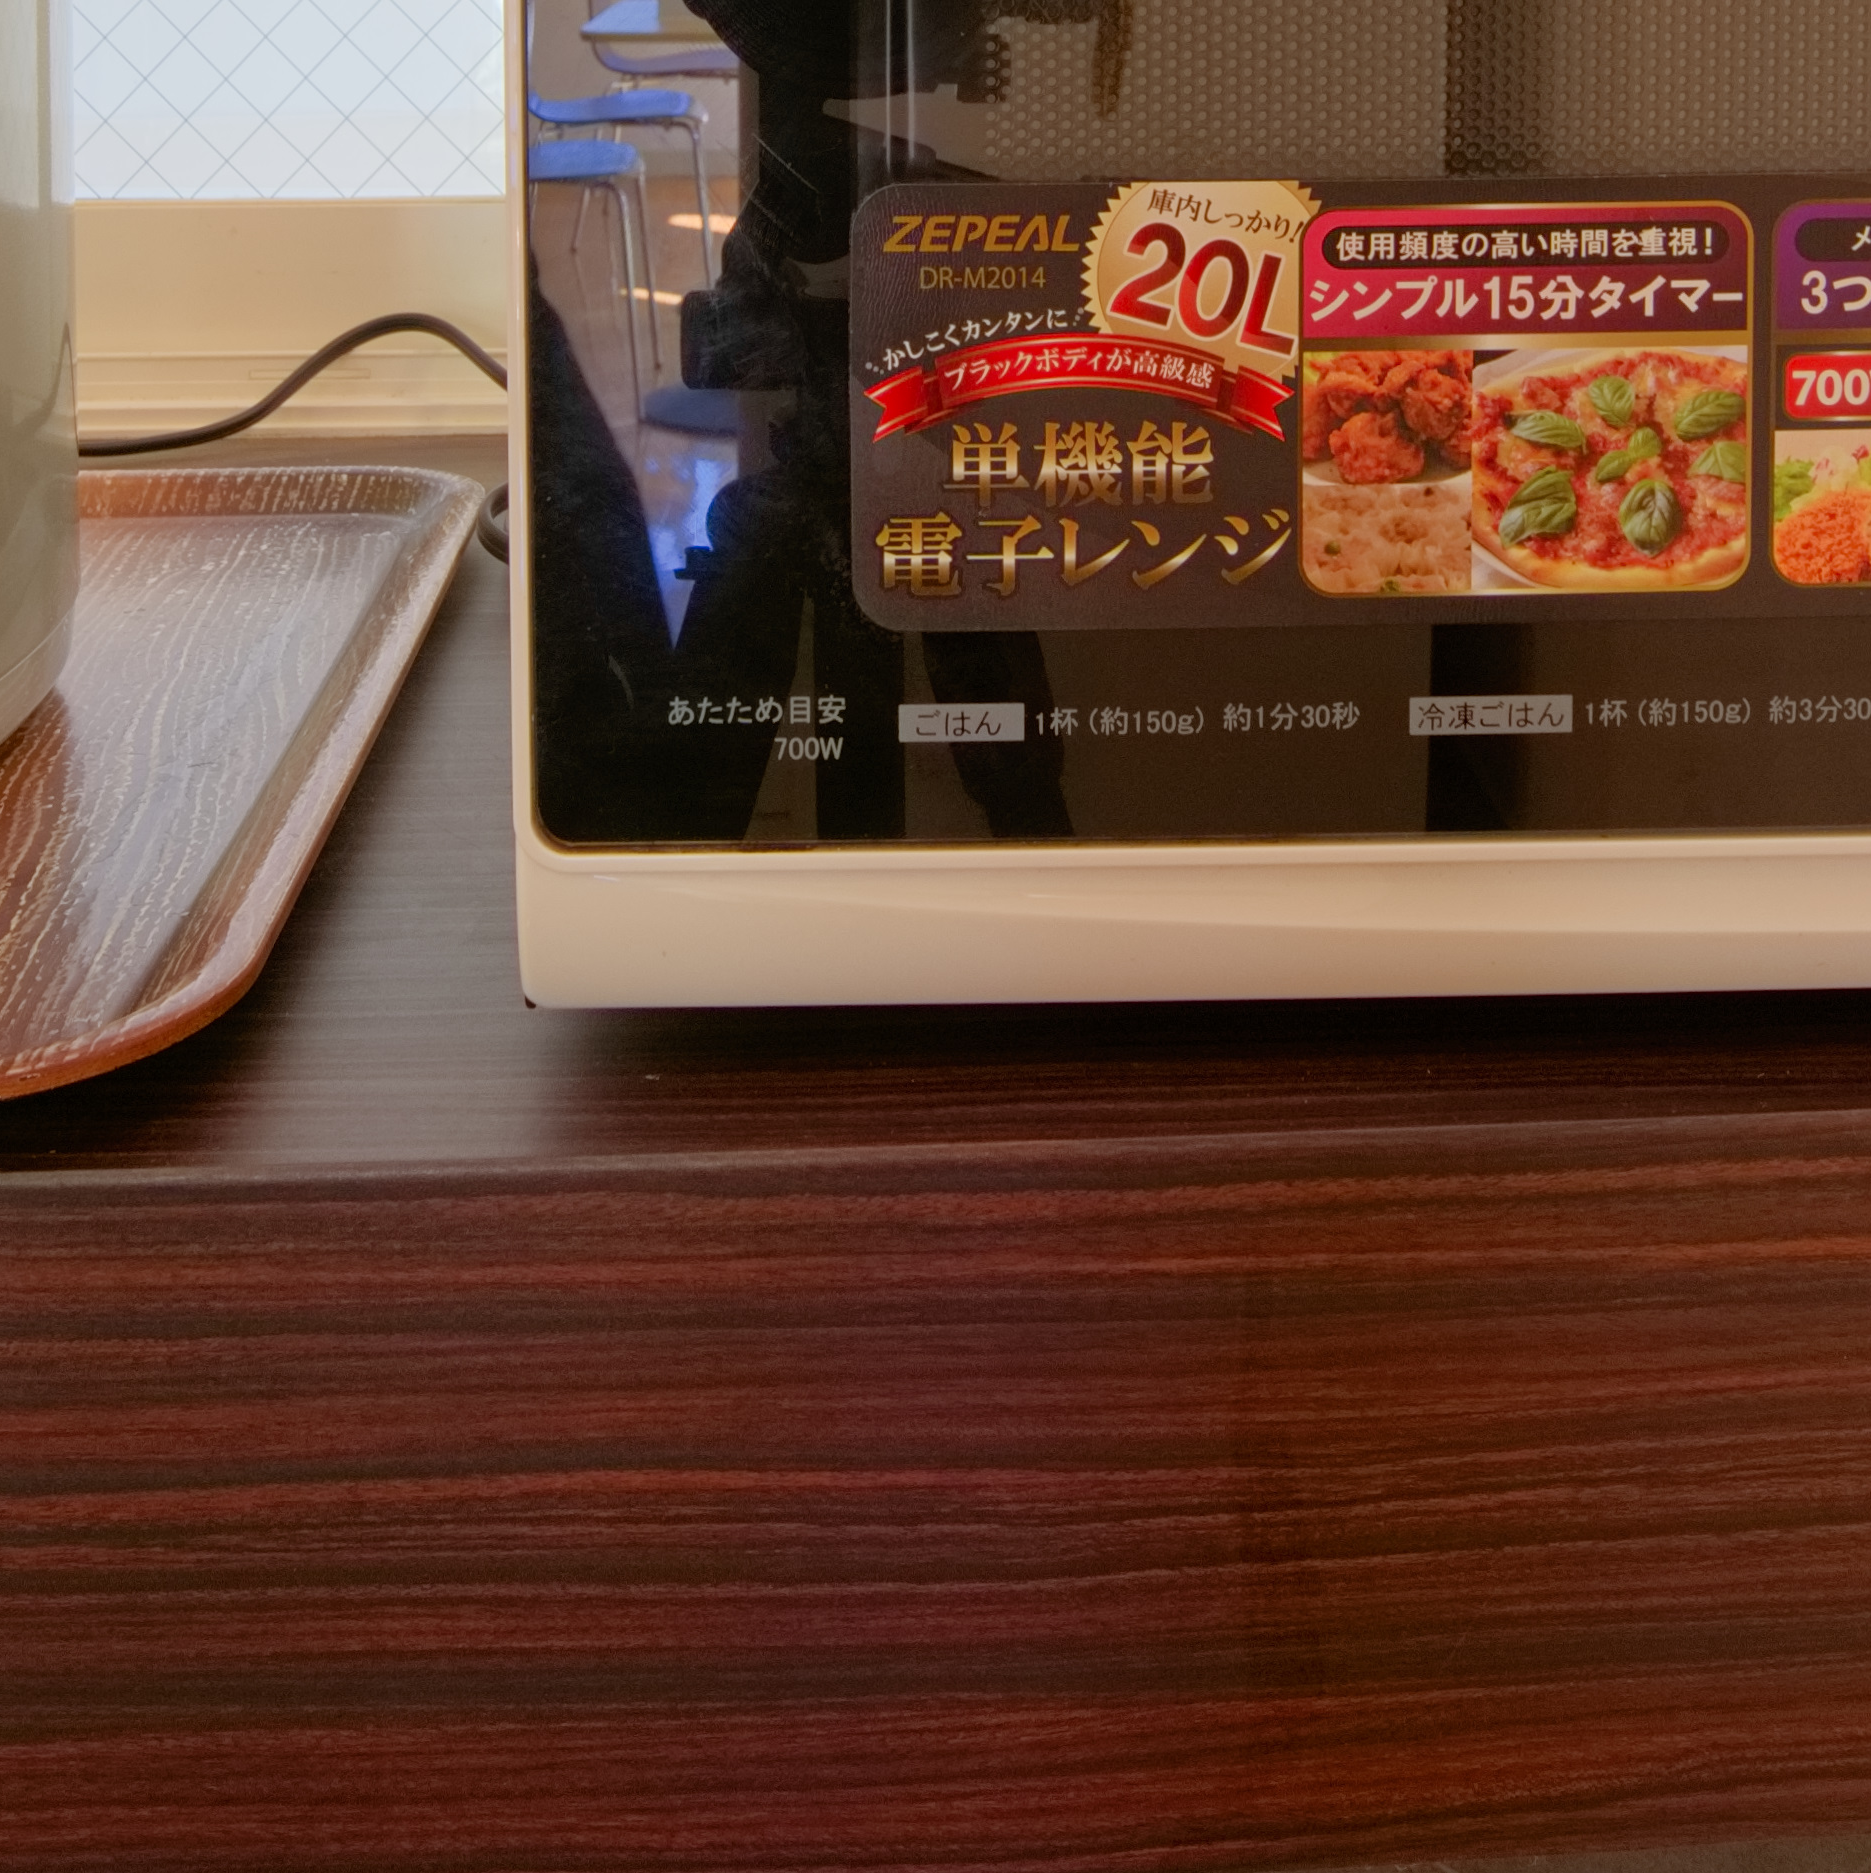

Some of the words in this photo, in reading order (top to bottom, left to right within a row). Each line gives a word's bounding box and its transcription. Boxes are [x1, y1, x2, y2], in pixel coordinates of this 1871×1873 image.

[883, 214, 1080, 253] ZEPEAL
[1147, 188, 1306, 245] 庫内しっかり！
[1336, 226, 1714, 262] 使用頻度の高い時間を重視！
[918, 265, 1047, 290] DR-M2014
[1106, 221, 1297, 358] 20L
[1309, 275, 1743, 322] シンプル15分タイマー
[882, 307, 1068, 371] かしこくカンタンに
[943, 346, 1216, 391] ブラックボディが高級感
[943, 421, 1215, 508] 単機能
[875, 508, 1293, 597] 電子レンジ
[667, 695, 847, 727] あたため目安
[915, 709, 1002, 737] ごはん
[1223, 701, 1361, 732] 約1分30秒
[1417, 701, 1565, 731] 冷凍ごはん
[774, 736, 844, 761] 700W
